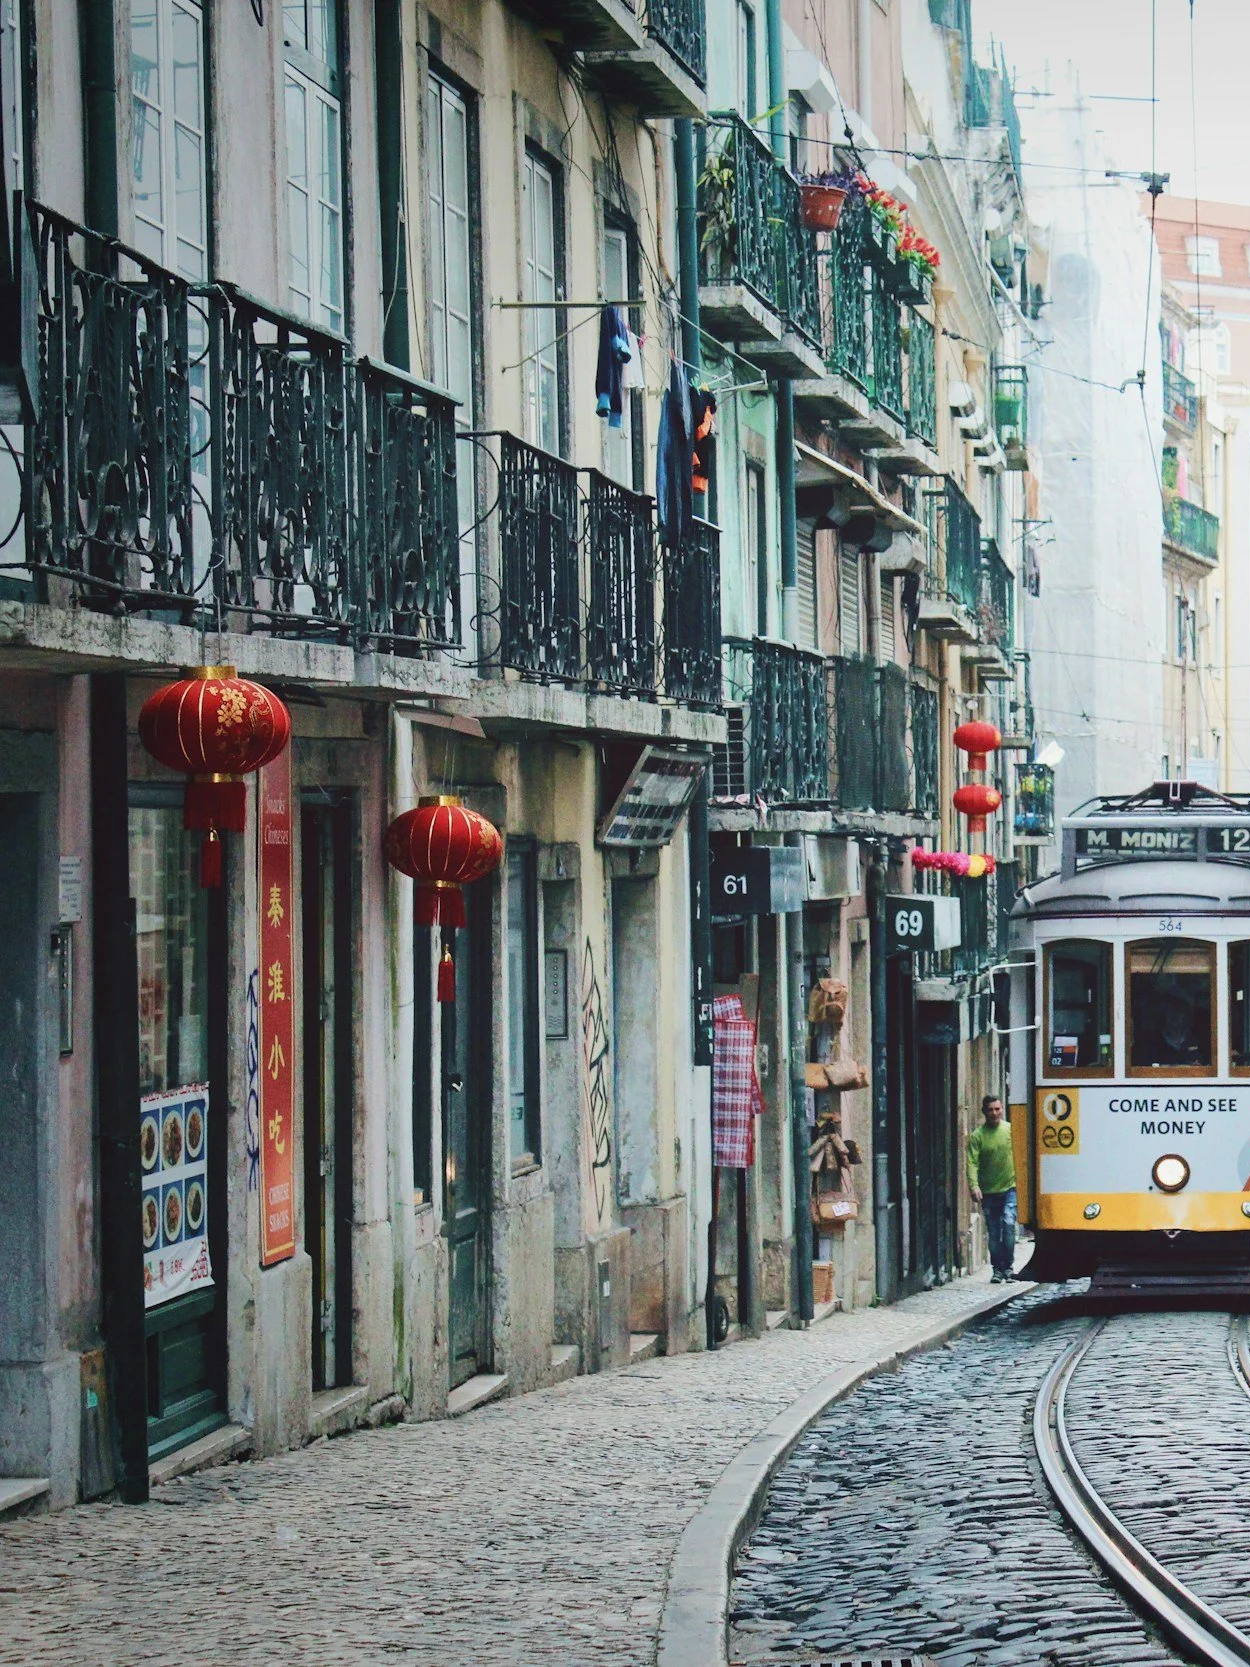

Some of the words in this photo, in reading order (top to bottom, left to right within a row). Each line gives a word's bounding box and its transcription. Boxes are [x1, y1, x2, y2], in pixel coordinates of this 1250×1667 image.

[1087, 830, 1110, 847] M.
[1121, 831, 1196, 849] MONIZ
[1220, 828, 1250, 851] 12
[723, 875, 748, 895] 61
[895, 910, 923, 937] 69
[1159, 920, 1182, 932] 564
[1109, 1099, 1159, 1112] COME
[1164, 1099, 1203, 1112] AND
[1208, 1099, 1237, 1112] SEE
[1141, 1121, 1206, 1135] MONEY
[269, 1185, 290, 1206] CHINESE
[269, 1209, 290, 1233] SNACKS
